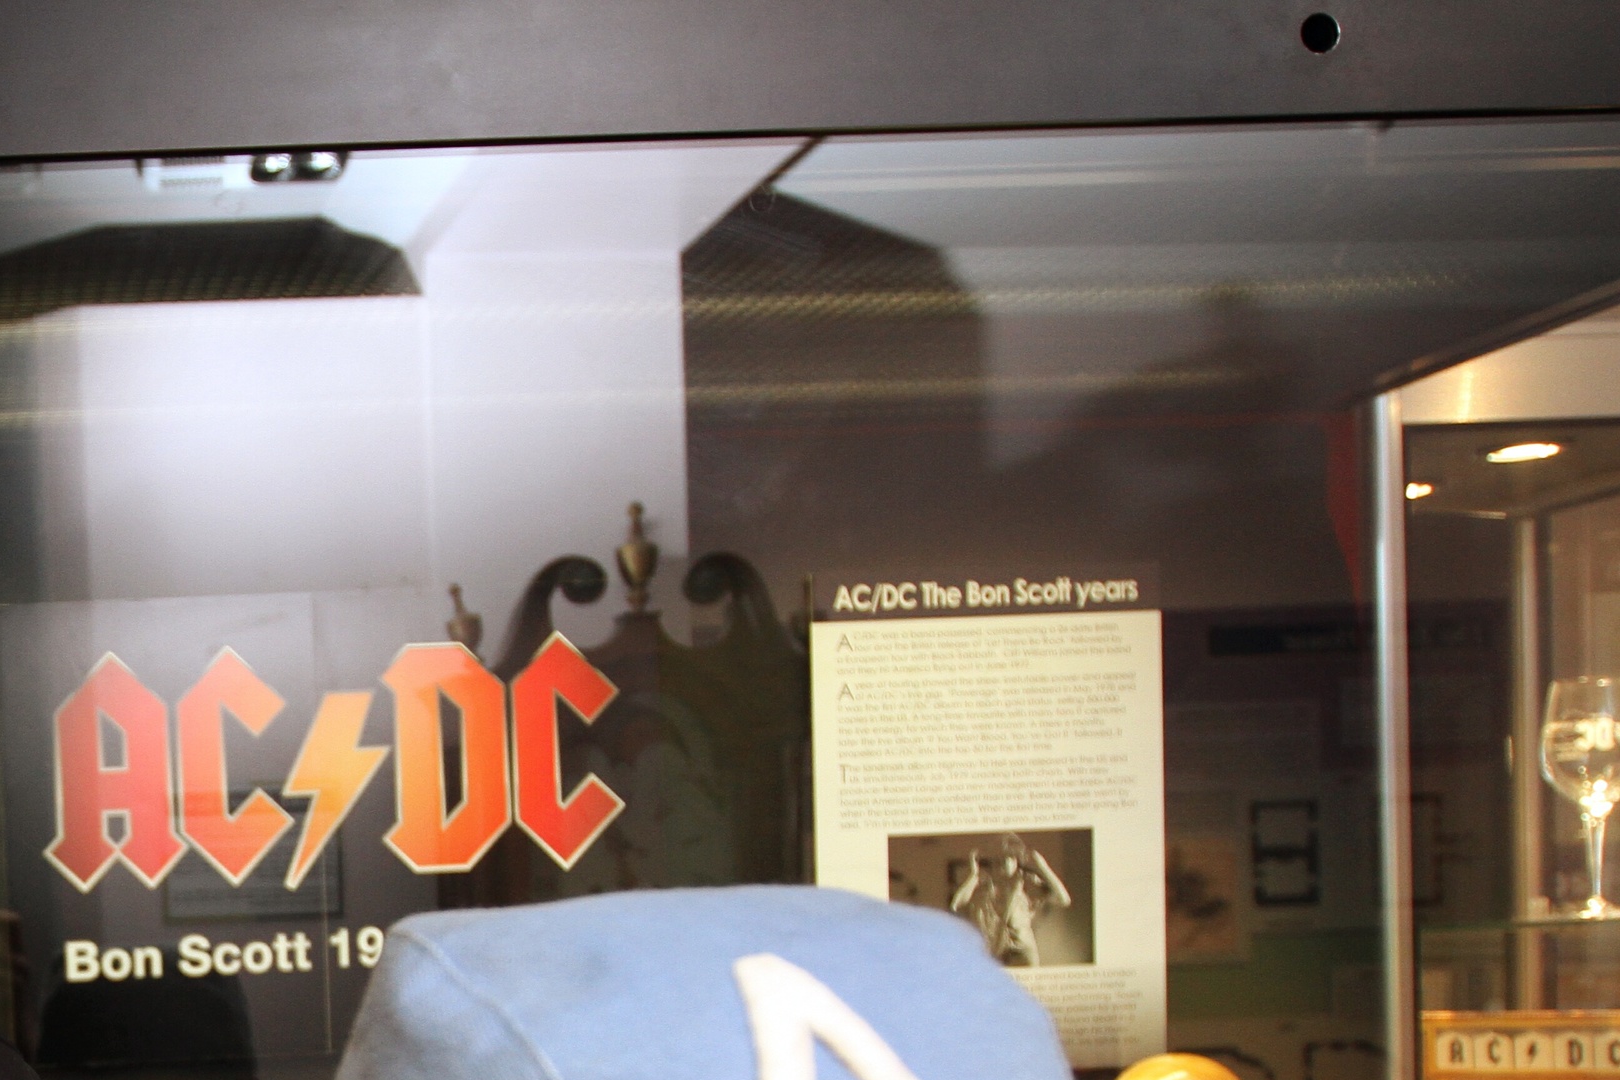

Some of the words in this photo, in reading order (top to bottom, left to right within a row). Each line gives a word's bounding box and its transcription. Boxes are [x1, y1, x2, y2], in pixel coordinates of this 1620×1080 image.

[833, 583, 917, 613] AC/DC
[920, 584, 962, 609] The
[966, 581, 1010, 607] Bon
[1013, 577, 1071, 607] Scott
[1076, 579, 1138, 608] years
[64, 940, 163, 982] Bon
[177, 930, 312, 977] Scott
